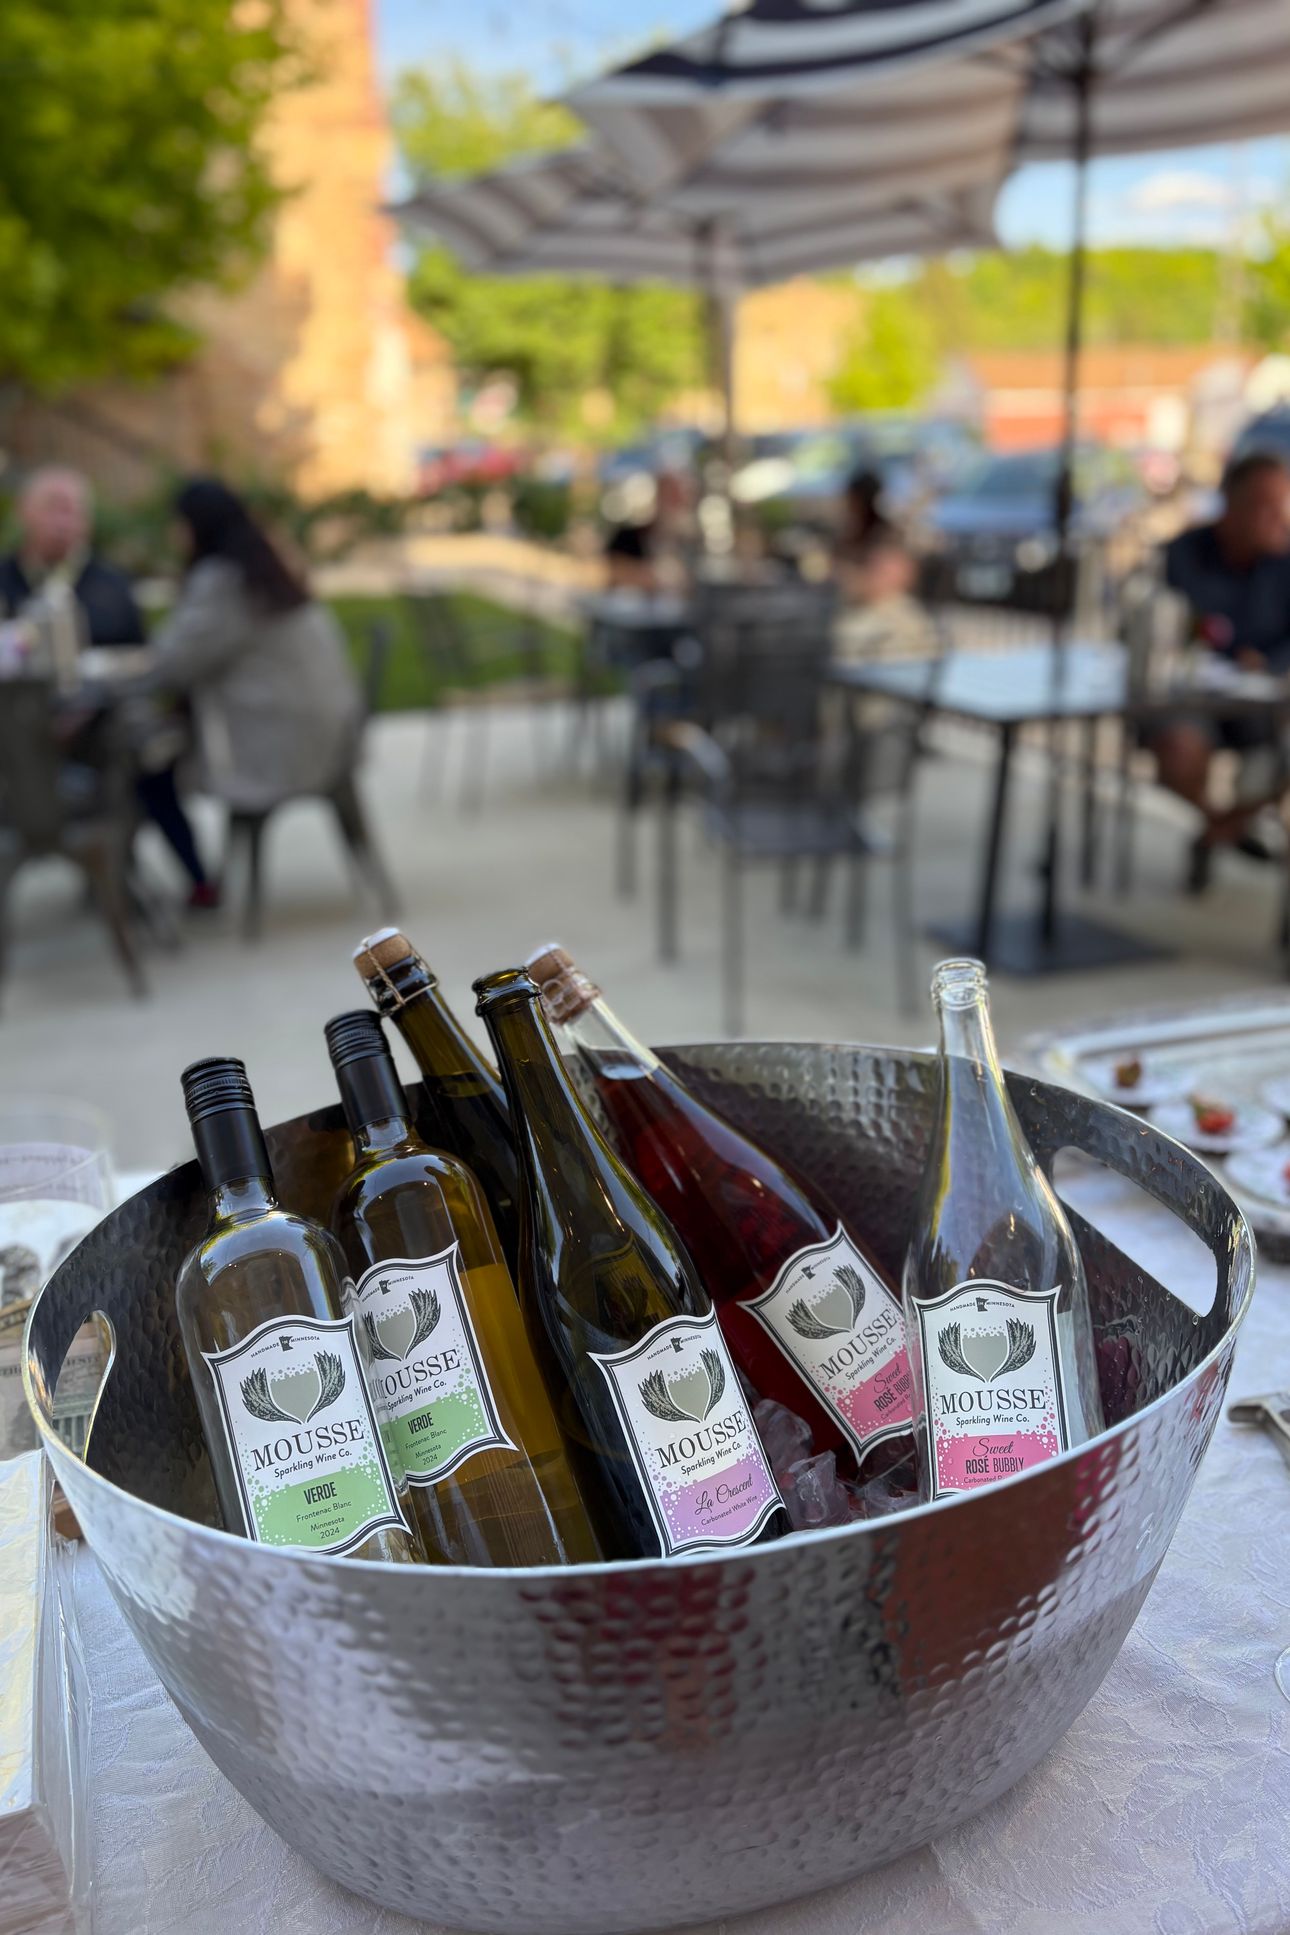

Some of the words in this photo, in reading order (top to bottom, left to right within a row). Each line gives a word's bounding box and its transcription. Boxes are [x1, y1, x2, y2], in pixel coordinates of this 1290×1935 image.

[950, 1302, 976, 1311] HANDMADE
[250, 1342, 280, 1358] HANDMADE
[290, 1335, 320, 1343] MINNESOTA
[646, 1344, 672, 1360] HANDMADE
[818, 1309, 899, 1380] MOUSSE
[846, 1356, 875, 1381] Sparkling
[871, 1343, 888, 1359] Wine
[886, 1336, 897, 1349] Co.
[873, 1362, 901, 1394] Sweet
[387, 1394, 413, 1412] Sparkling
[414, 1385, 432, 1396] Wine
[433, 1379, 447, 1389] Co.
[873, 1386, 898, 1412] ROSÉ
[940, 1388, 1047, 1415] MOUSSE
[407, 1412, 434, 1435] VERDE
[956, 1415, 991, 1428] Sparkling
[993, 1413, 1015, 1423] Wine
[1015, 1413, 1030, 1423] Co.
[251, 1419, 365, 1472] MOUSSE
[405, 1434, 430, 1450] Frontenac
[430, 1428, 447, 1441] Blanc
[655, 1410, 747, 1469] MOUSSE
[972, 1439, 1014, 1457] Sweet
[415, 1444, 442, 1459] Minnesota
[422, 1454, 438, 1466] 2024
[681, 1455, 716, 1475] Sparkling
[715, 1447, 732, 1460] Wine
[732, 1441, 743, 1452] Co.
[274, 1458, 314, 1480] Sparkling
[315, 1451, 337, 1465] Wine
[338, 1447, 353, 1459] Co.
[965, 1456, 990, 1474] ROSÉ
[992, 1457, 1025, 1473] BUBBLY
[963, 1475, 997, 1484] Carbonated
[303, 1481, 338, 1505] VERDE
[694, 1490, 714, 1516] La
[716, 1473, 754, 1504] Crescent
[296, 1506, 332, 1523] Frontenac
[333, 1500, 352, 1513] Blanc
[700, 1507, 733, 1526] Carbonated
[731, 1500, 746, 1513] White
[745, 1495, 758, 1508] Wine
[310, 1517, 345, 1532] Minnesota
[320, 1528, 340, 1539] 2024
